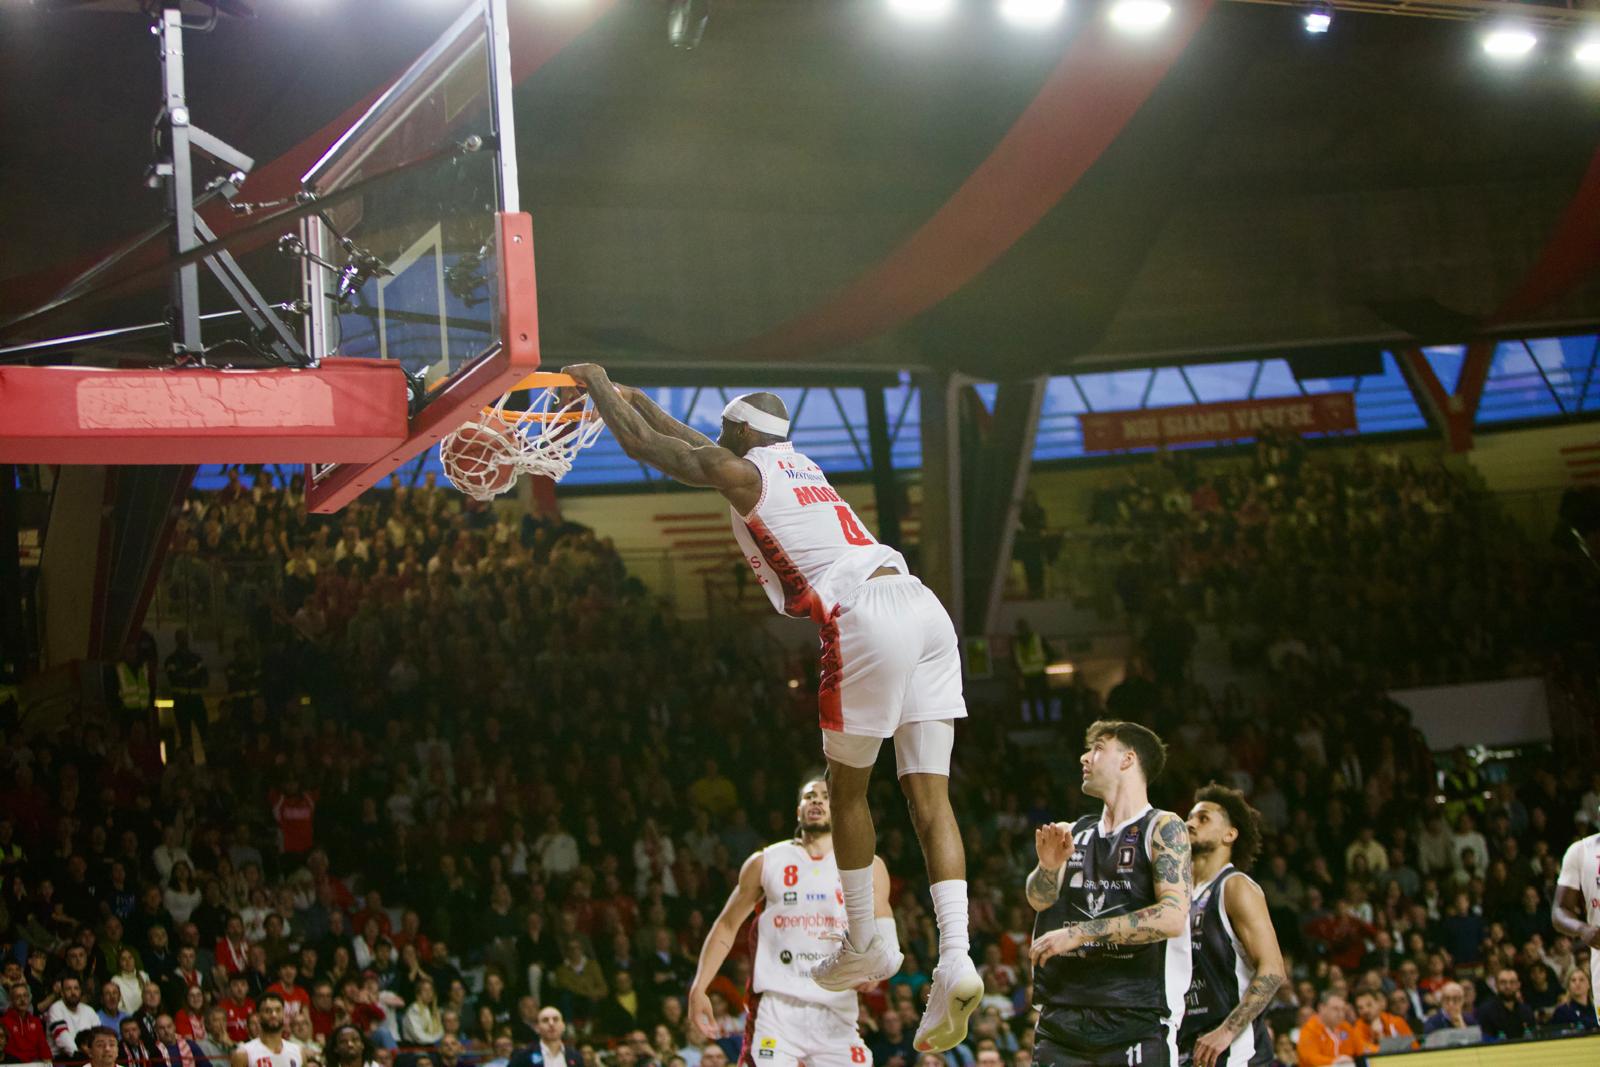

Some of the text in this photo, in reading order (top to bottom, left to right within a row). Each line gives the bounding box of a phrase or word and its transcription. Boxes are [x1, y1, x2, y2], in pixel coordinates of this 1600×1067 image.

[1161, 411, 1230, 436] SIAMO
[1233, 403, 1315, 430] VARESE
[784, 865, 798, 887] 8
[1110, 879, 1132, 890] ASTM
[849, 1045, 866, 1064] 8
[1126, 1042, 1142, 1067] 11
